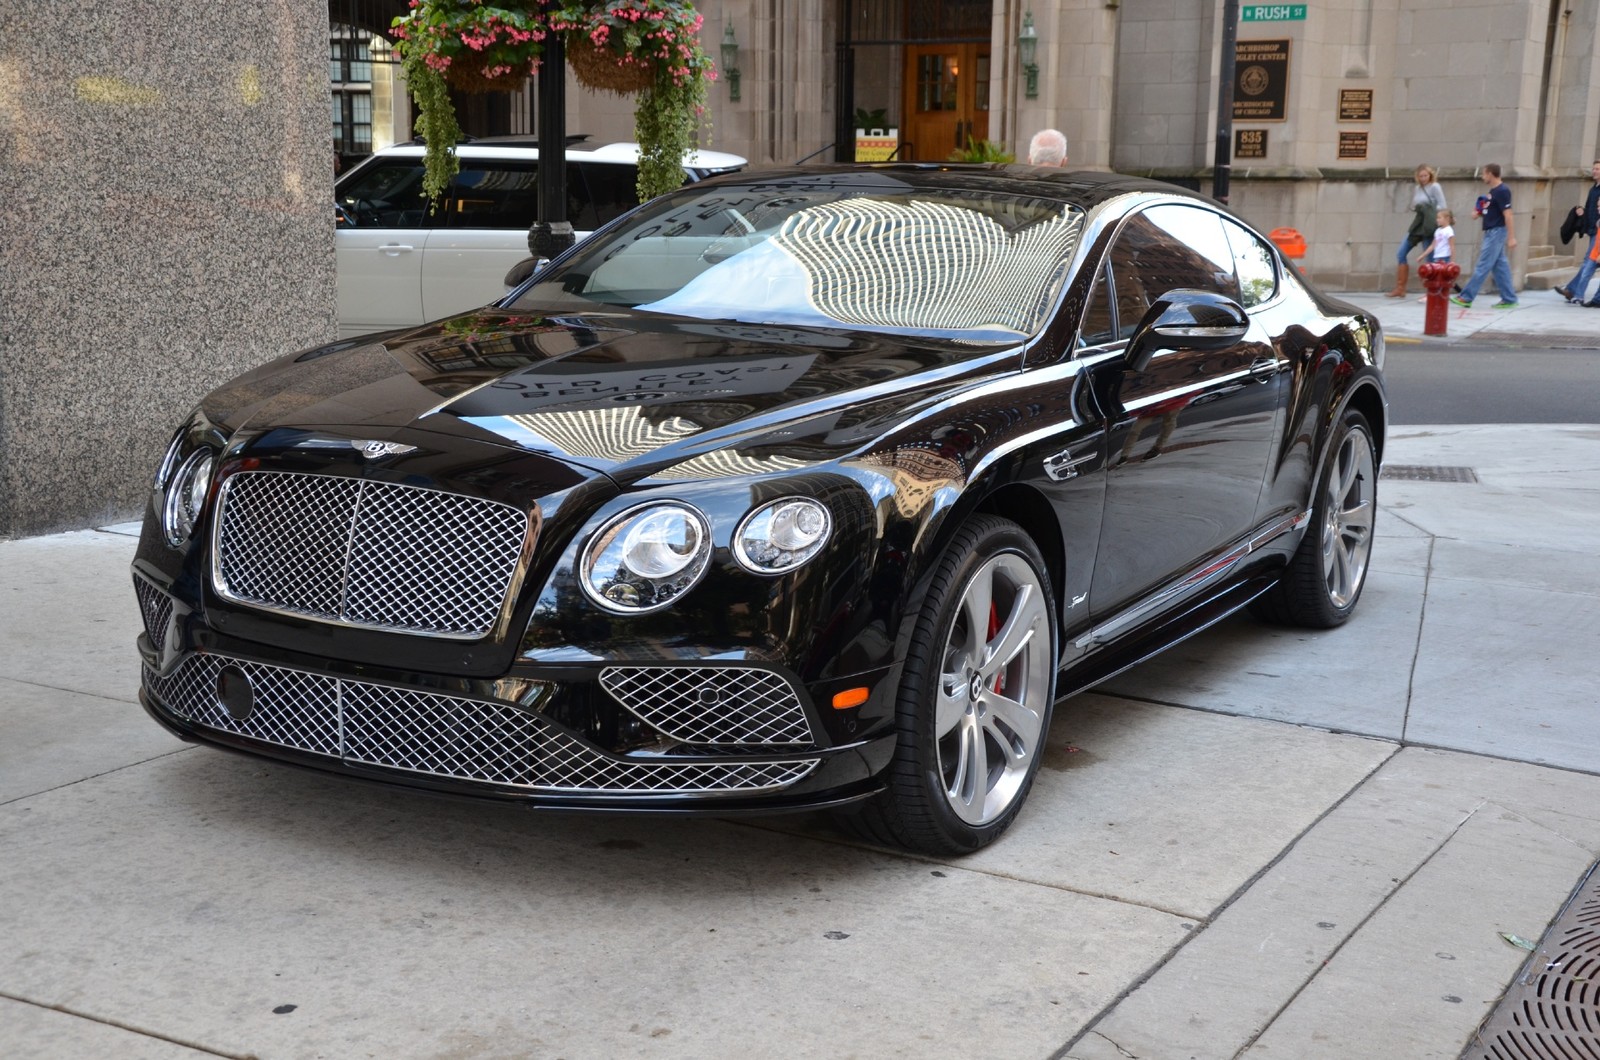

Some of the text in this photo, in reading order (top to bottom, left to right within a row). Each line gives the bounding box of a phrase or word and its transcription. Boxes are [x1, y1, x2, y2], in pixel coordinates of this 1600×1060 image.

[1246, 7, 1303, 20] N RUSH ST
[1241, 132, 1262, 143] 835
